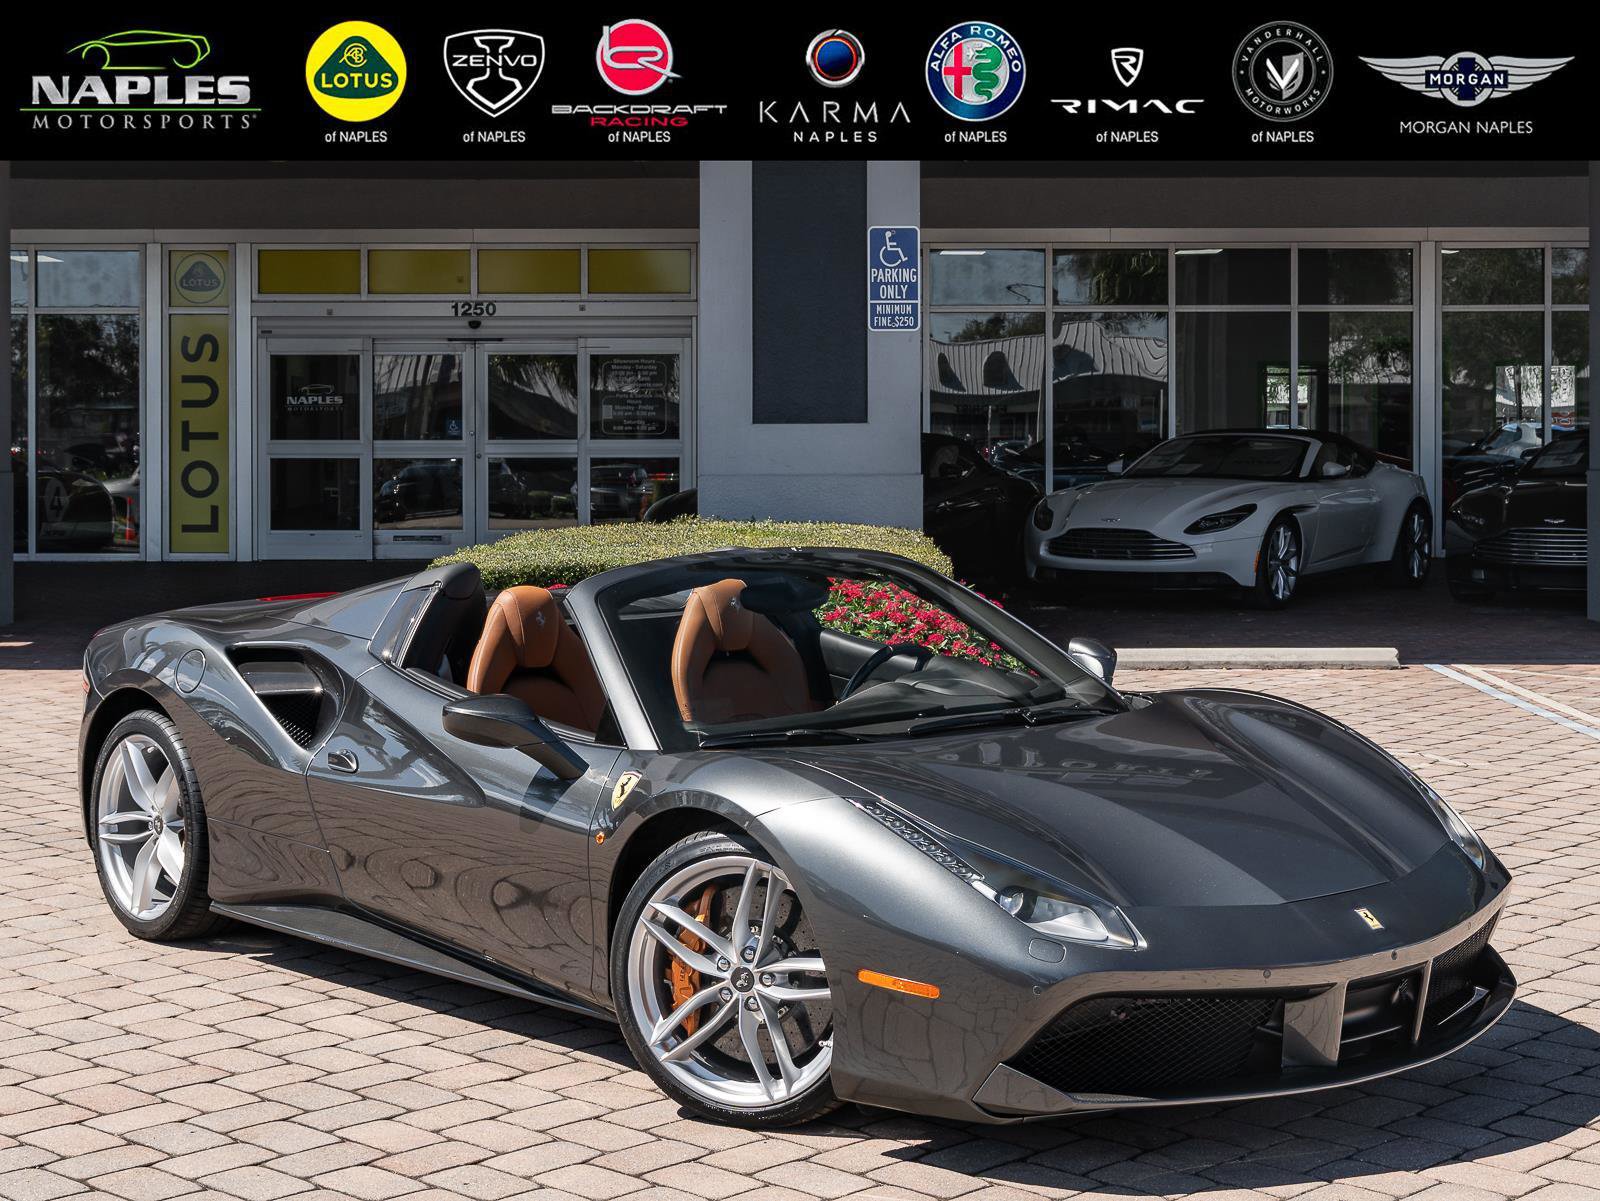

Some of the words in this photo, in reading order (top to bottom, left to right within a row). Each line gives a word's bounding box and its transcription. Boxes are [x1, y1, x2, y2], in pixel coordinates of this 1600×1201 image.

[871, 268, 916, 283] PARKING
[183, 278, 218, 287] LOTUS
[879, 284, 908, 299] ONLY
[451, 301, 497, 317] 1250
[876, 304, 912, 315] MINIMUM
[874, 316, 892, 327] FINE
[895, 316, 914, 327] $250
[286, 396, 343, 405] NAPLES
[181, 333, 220, 533] LOTUS
